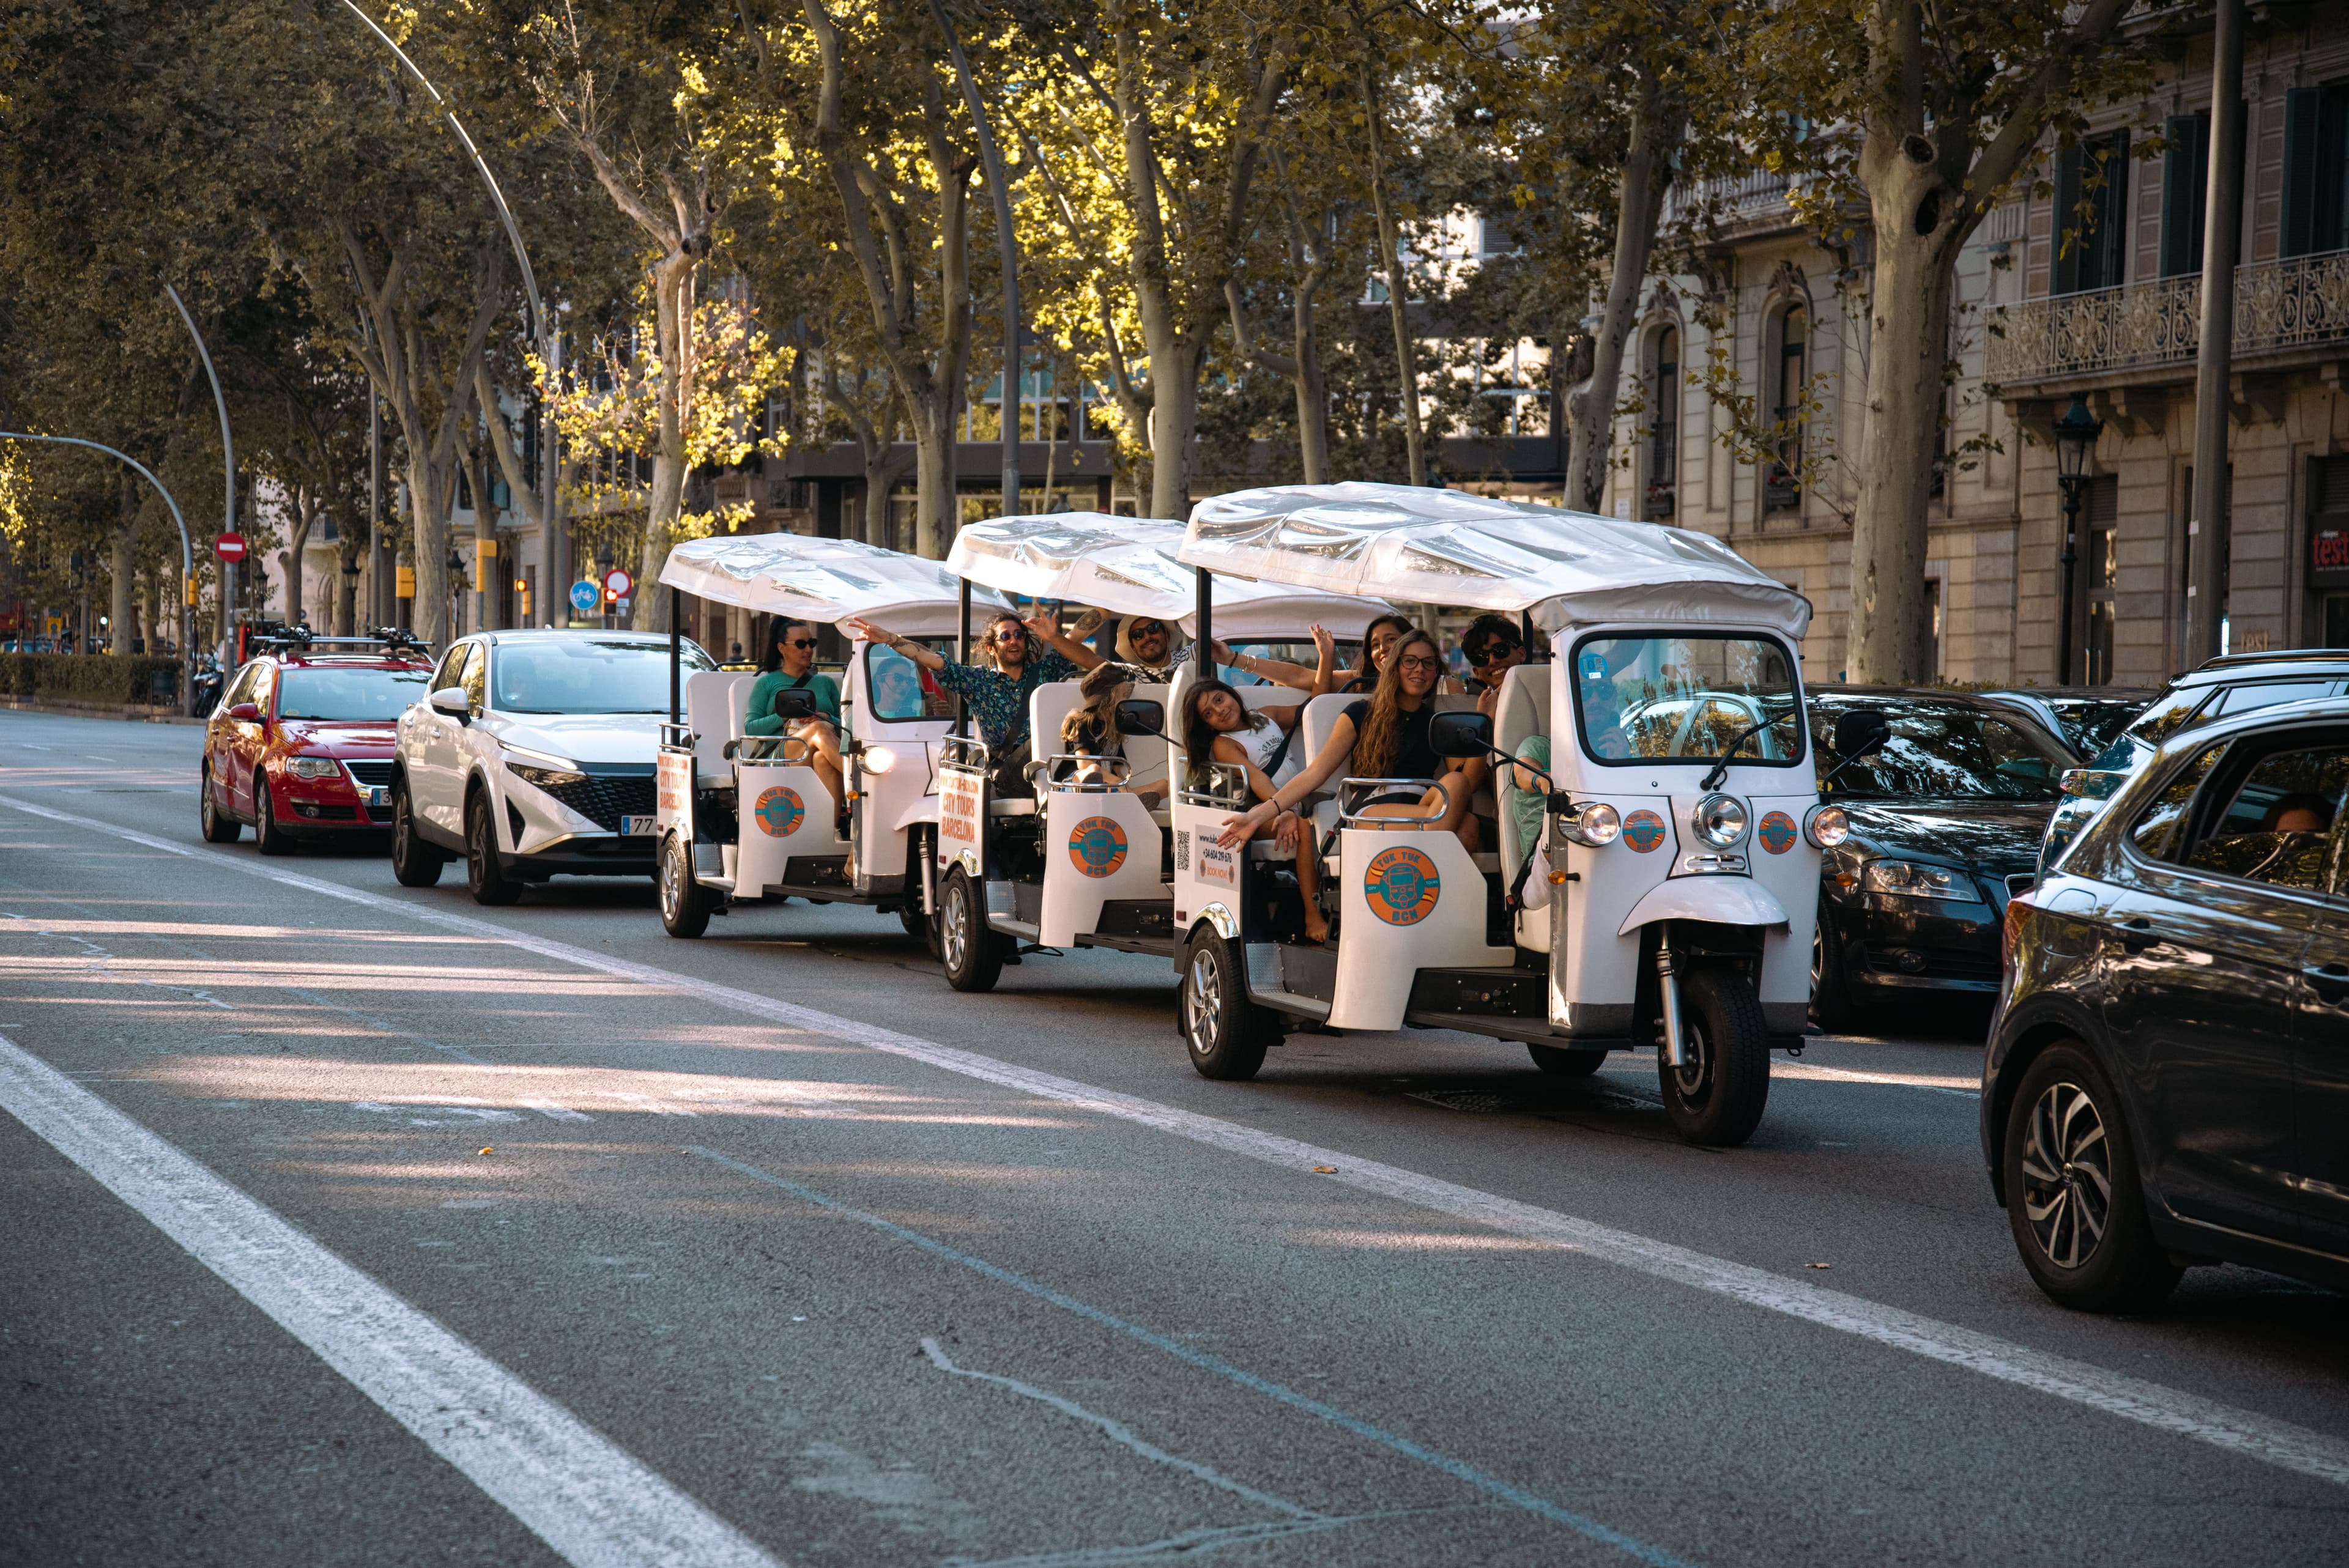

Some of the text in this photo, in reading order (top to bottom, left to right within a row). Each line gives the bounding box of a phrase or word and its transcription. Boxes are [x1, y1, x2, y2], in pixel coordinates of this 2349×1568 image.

[661, 771, 670, 788] CITY
[943, 793, 974, 818] CITY TOURS
[634, 818, 657, 832] 77
[942, 816, 974, 843] BARCELONA
[1376, 852, 1420, 867] TUK TUK
[1392, 909, 1418, 922] BCN
